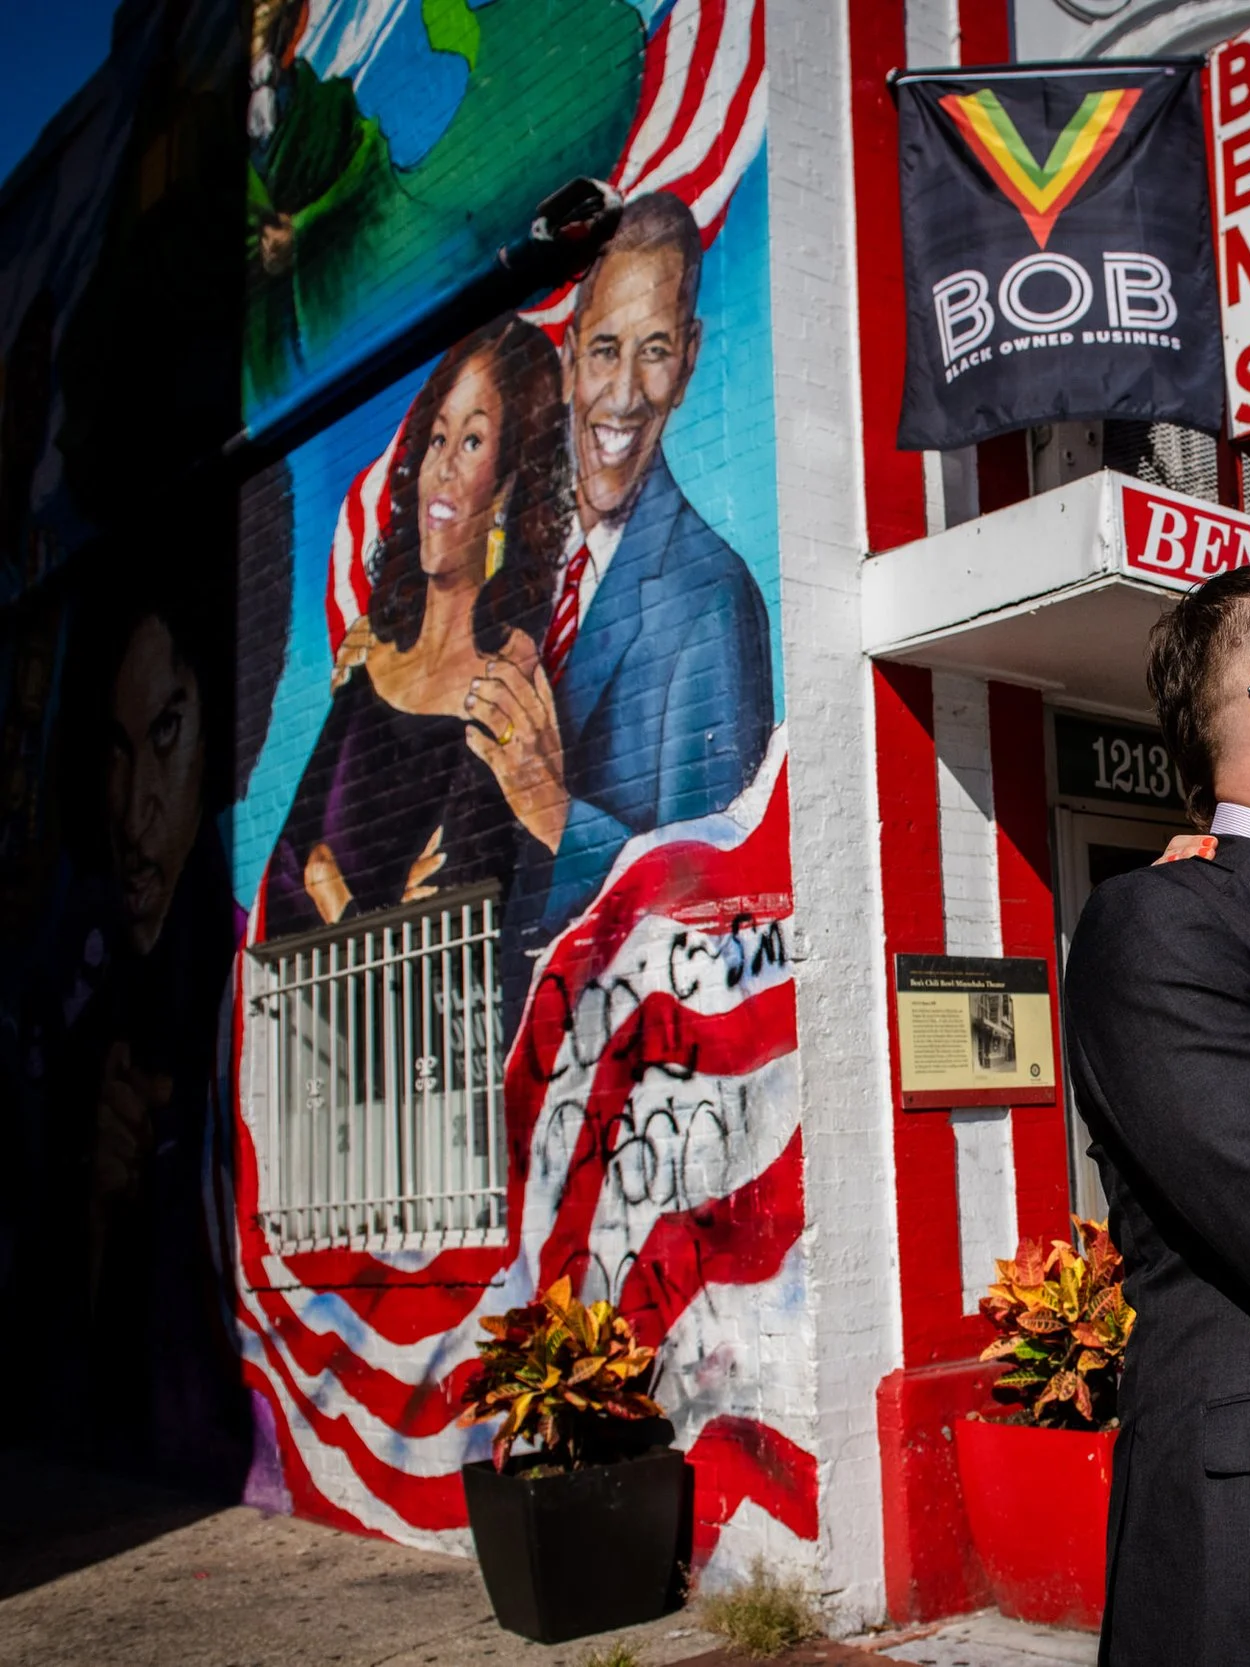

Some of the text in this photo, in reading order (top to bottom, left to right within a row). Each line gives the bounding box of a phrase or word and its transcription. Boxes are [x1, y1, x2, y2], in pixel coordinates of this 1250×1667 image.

[932, 251, 1179, 368] BOB
[945, 330, 1183, 385] BLACK OWNED BUSINESS
[1091, 735, 1171, 799] 1213
